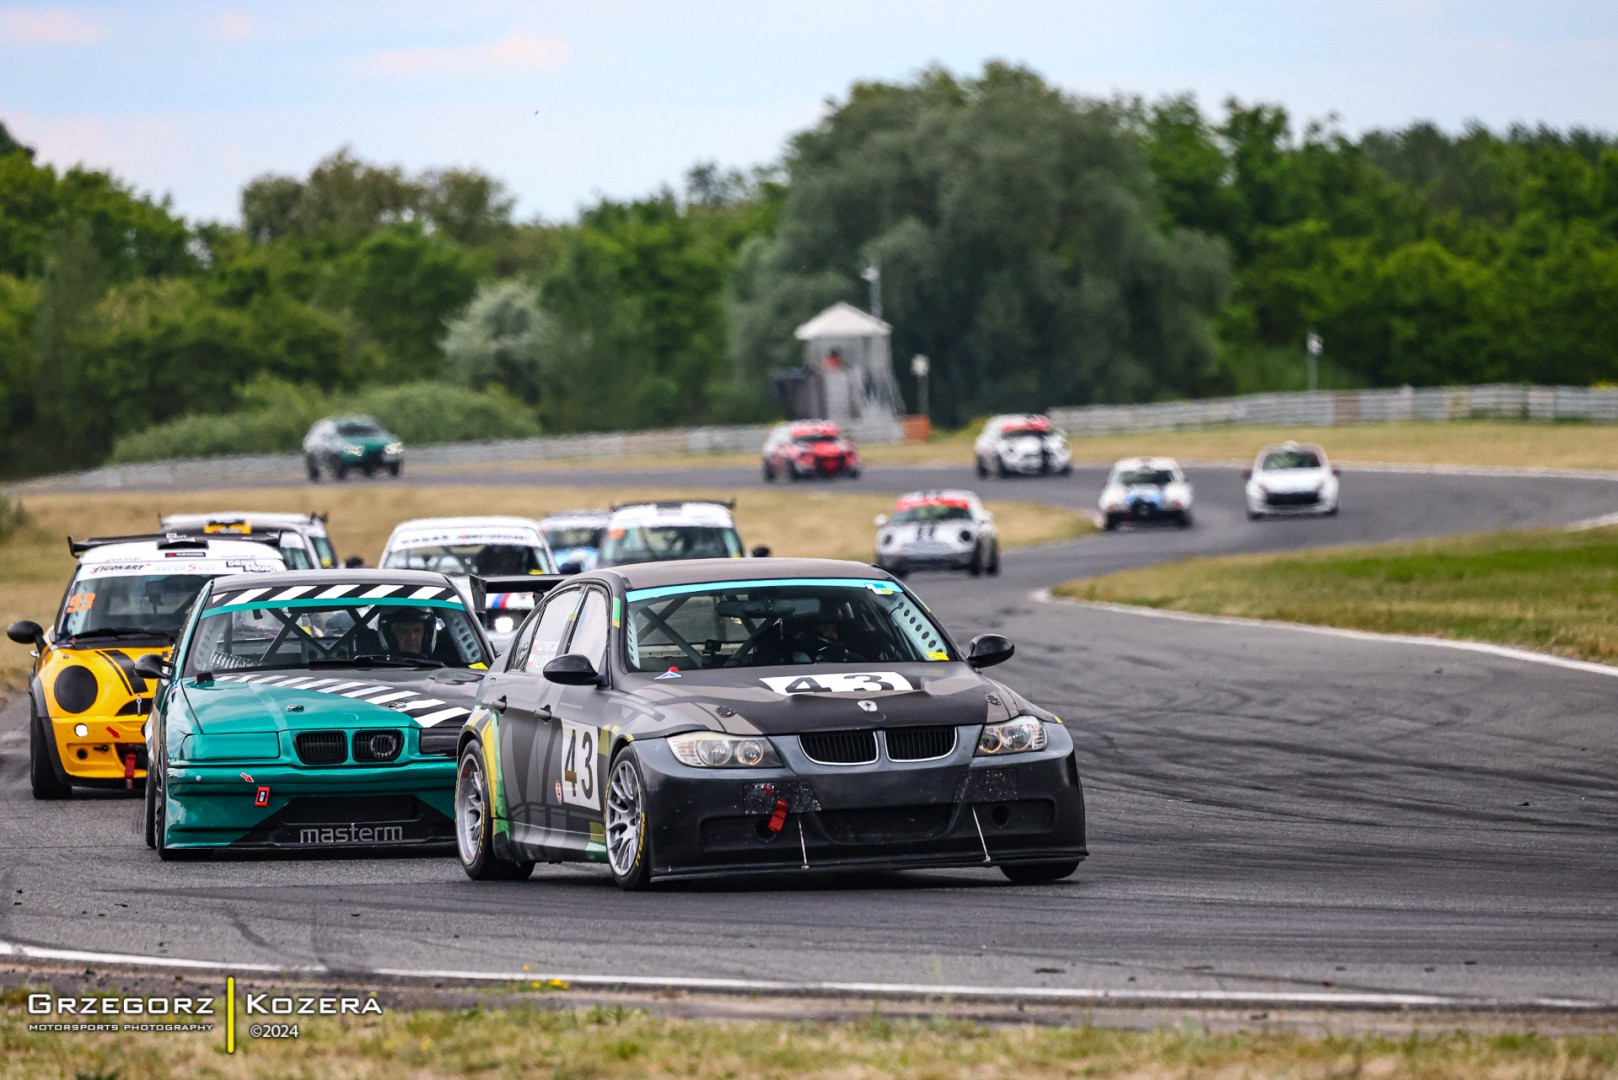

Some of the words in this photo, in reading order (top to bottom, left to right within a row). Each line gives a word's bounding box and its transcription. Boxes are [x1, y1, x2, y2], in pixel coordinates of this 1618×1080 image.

[66, 592, 97, 613] 93
[785, 674, 895, 693] 43
[564, 728, 593, 800] 43
[300, 822, 403, 843] masterm
